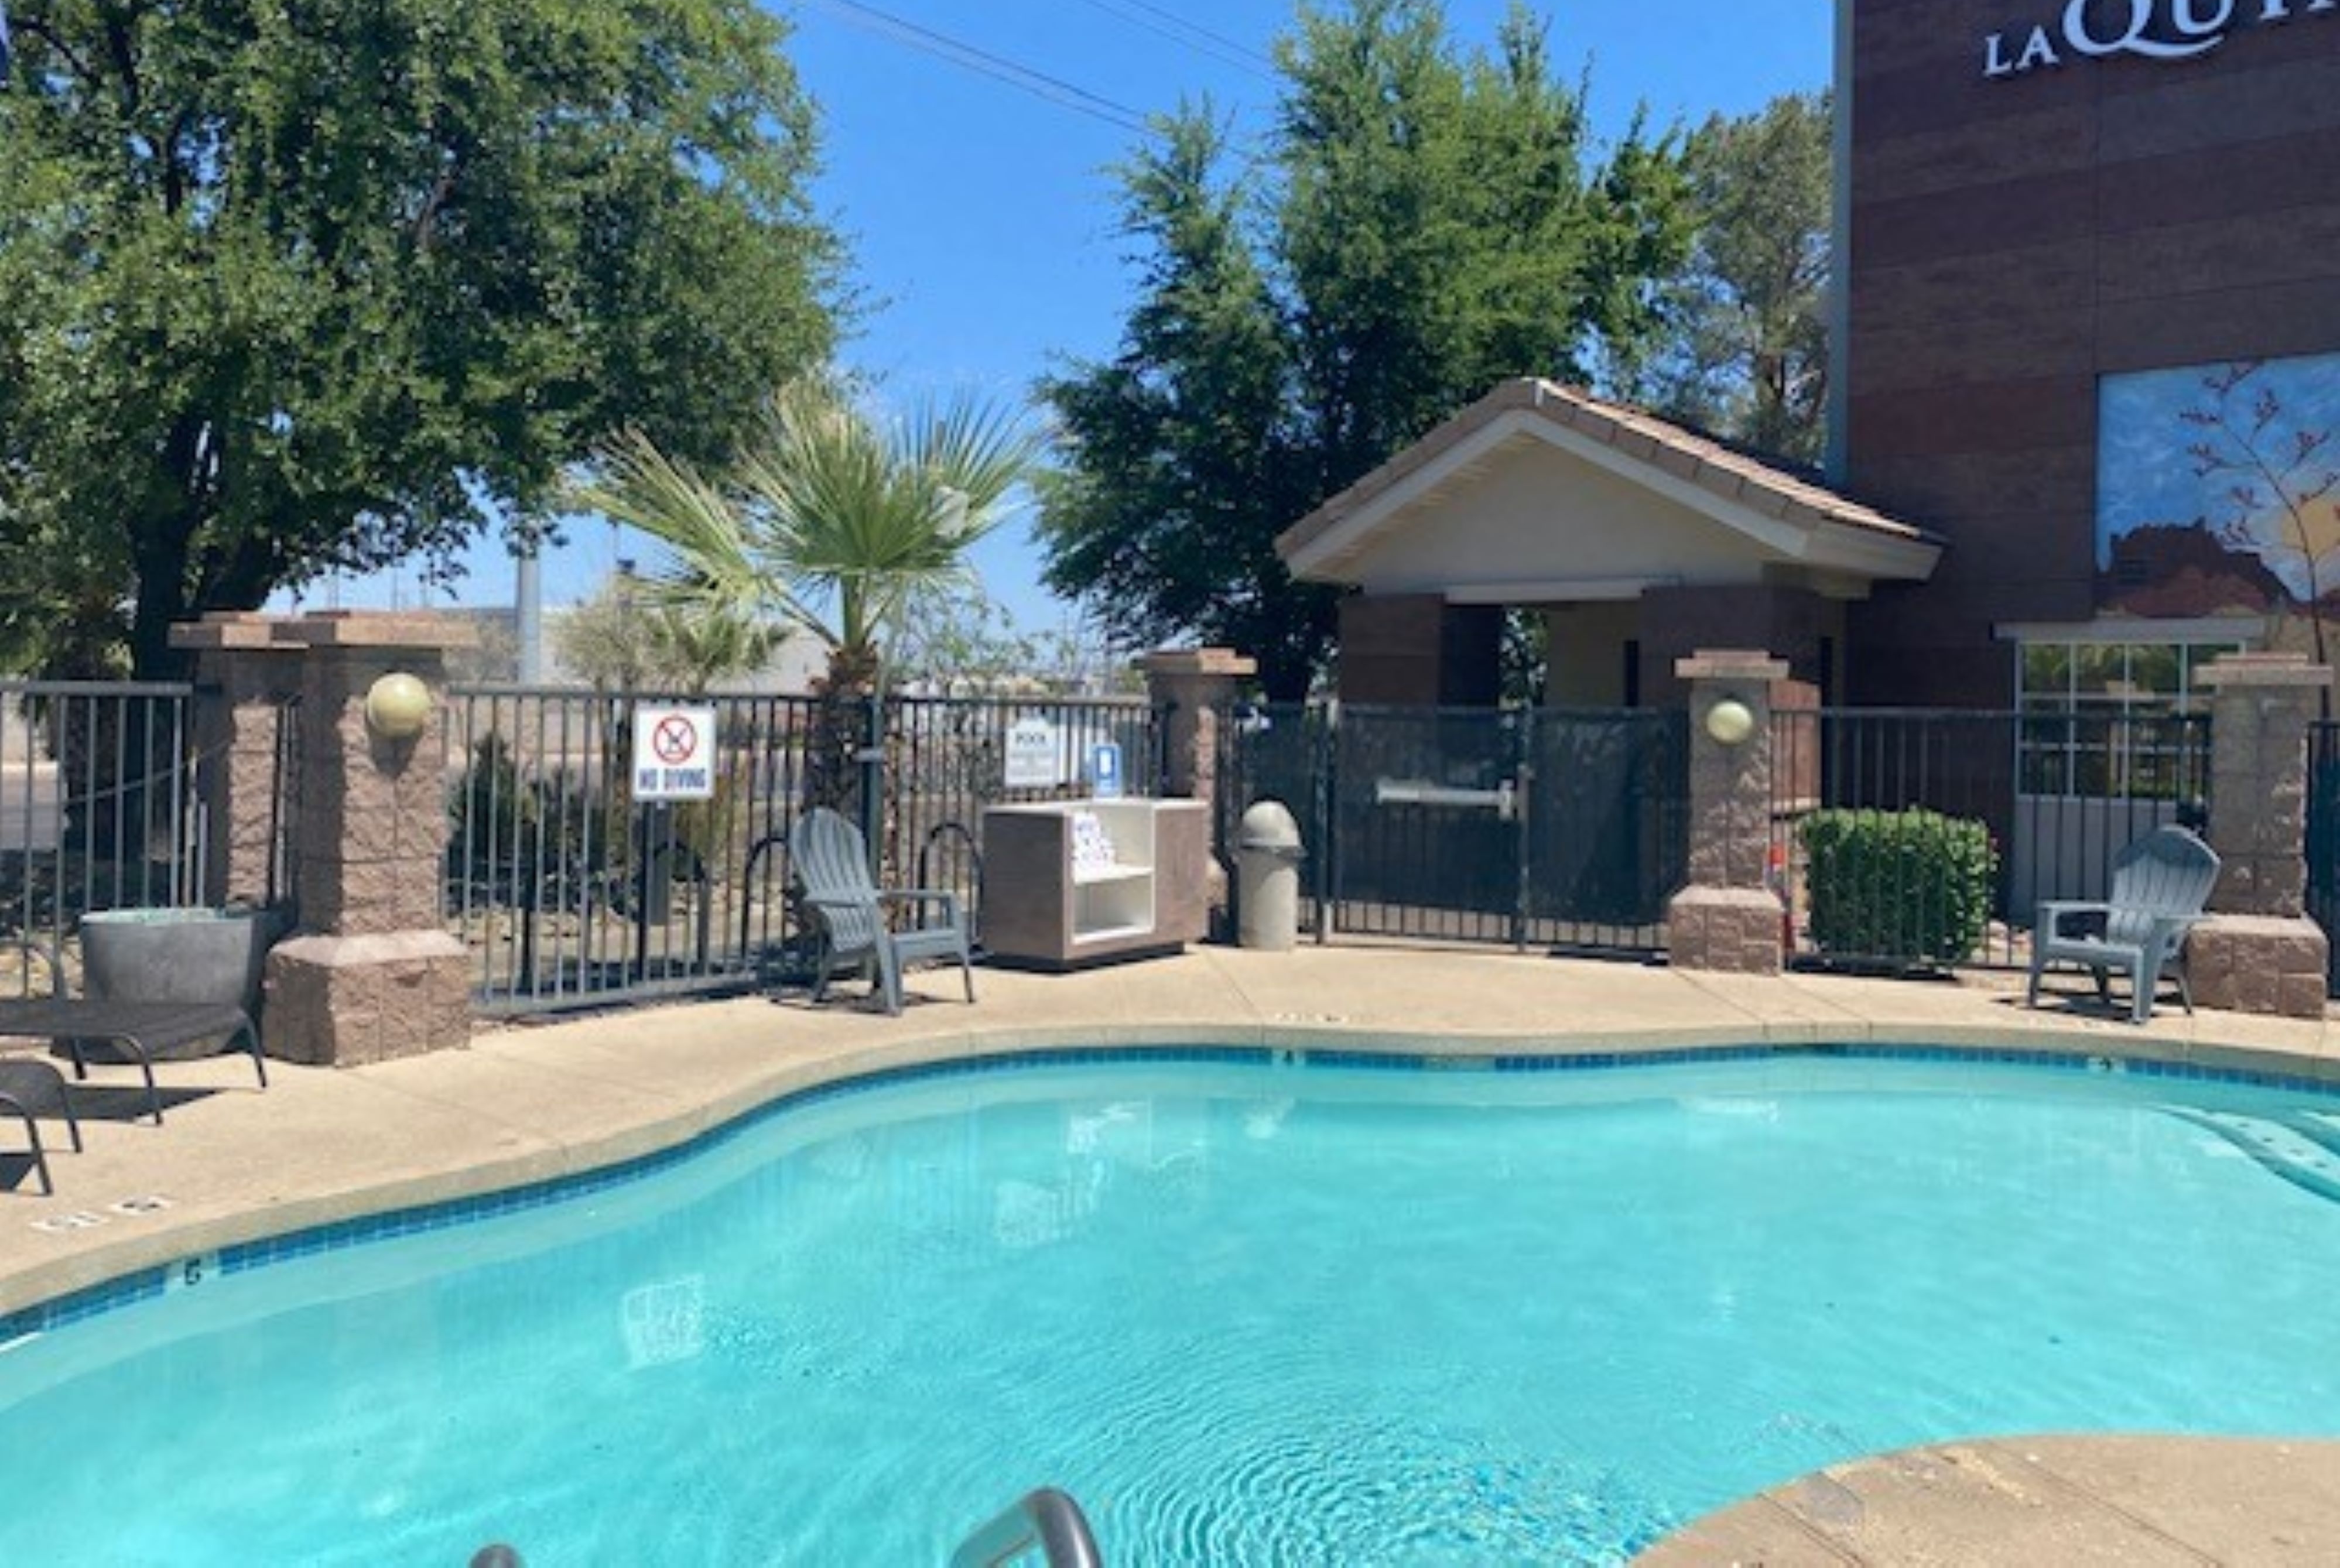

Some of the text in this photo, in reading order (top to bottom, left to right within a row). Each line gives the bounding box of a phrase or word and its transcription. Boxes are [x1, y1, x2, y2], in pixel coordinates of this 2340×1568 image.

[1983, 25, 2059, 76] LA
[639, 768, 706, 790] NO DIVING
